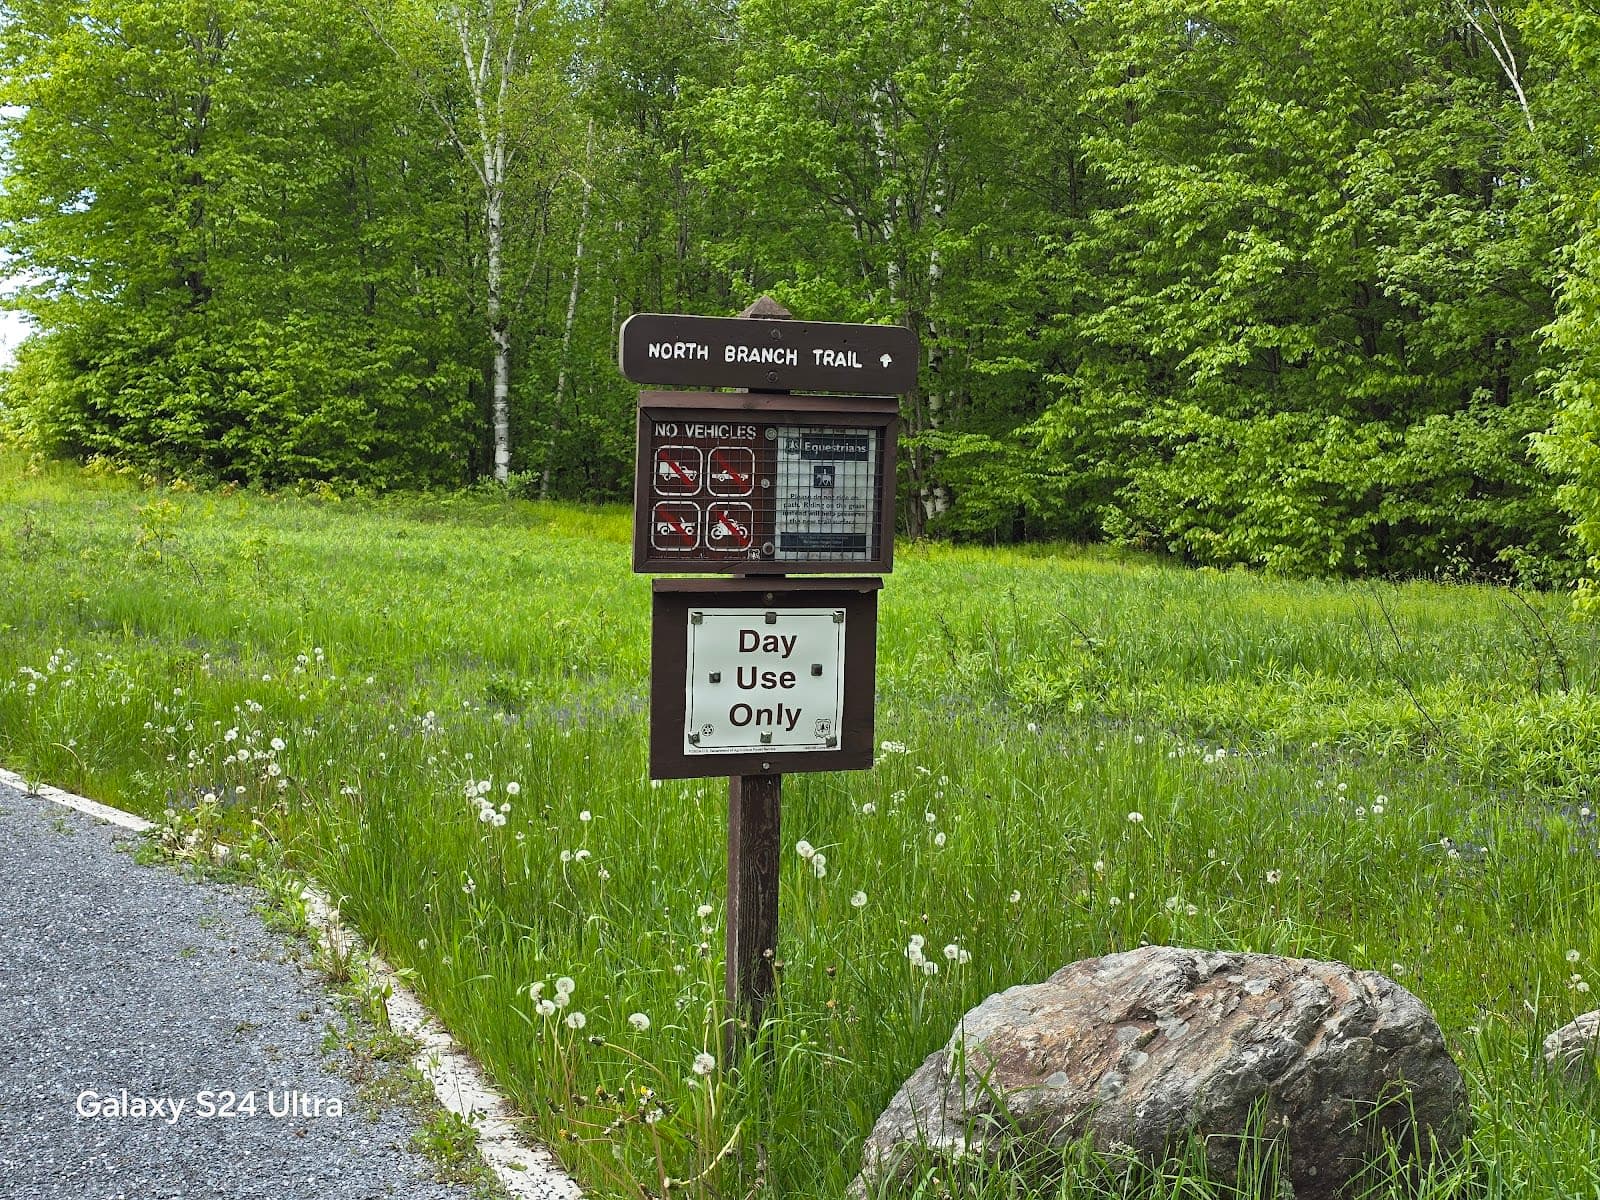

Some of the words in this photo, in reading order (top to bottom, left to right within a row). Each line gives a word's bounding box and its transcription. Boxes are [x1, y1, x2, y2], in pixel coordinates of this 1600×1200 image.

[648, 342, 709, 361] NORTH
[724, 345, 798, 366] BRANCH
[812, 349, 863, 368] TRAIL
[654, 423, 678, 437] NO
[685, 424, 757, 440] VEHICLES
[804, 441, 867, 454] Equestrians
[739, 629, 797, 659] Day
[737, 666, 796, 690] Use
[729, 703, 802, 732] Only
